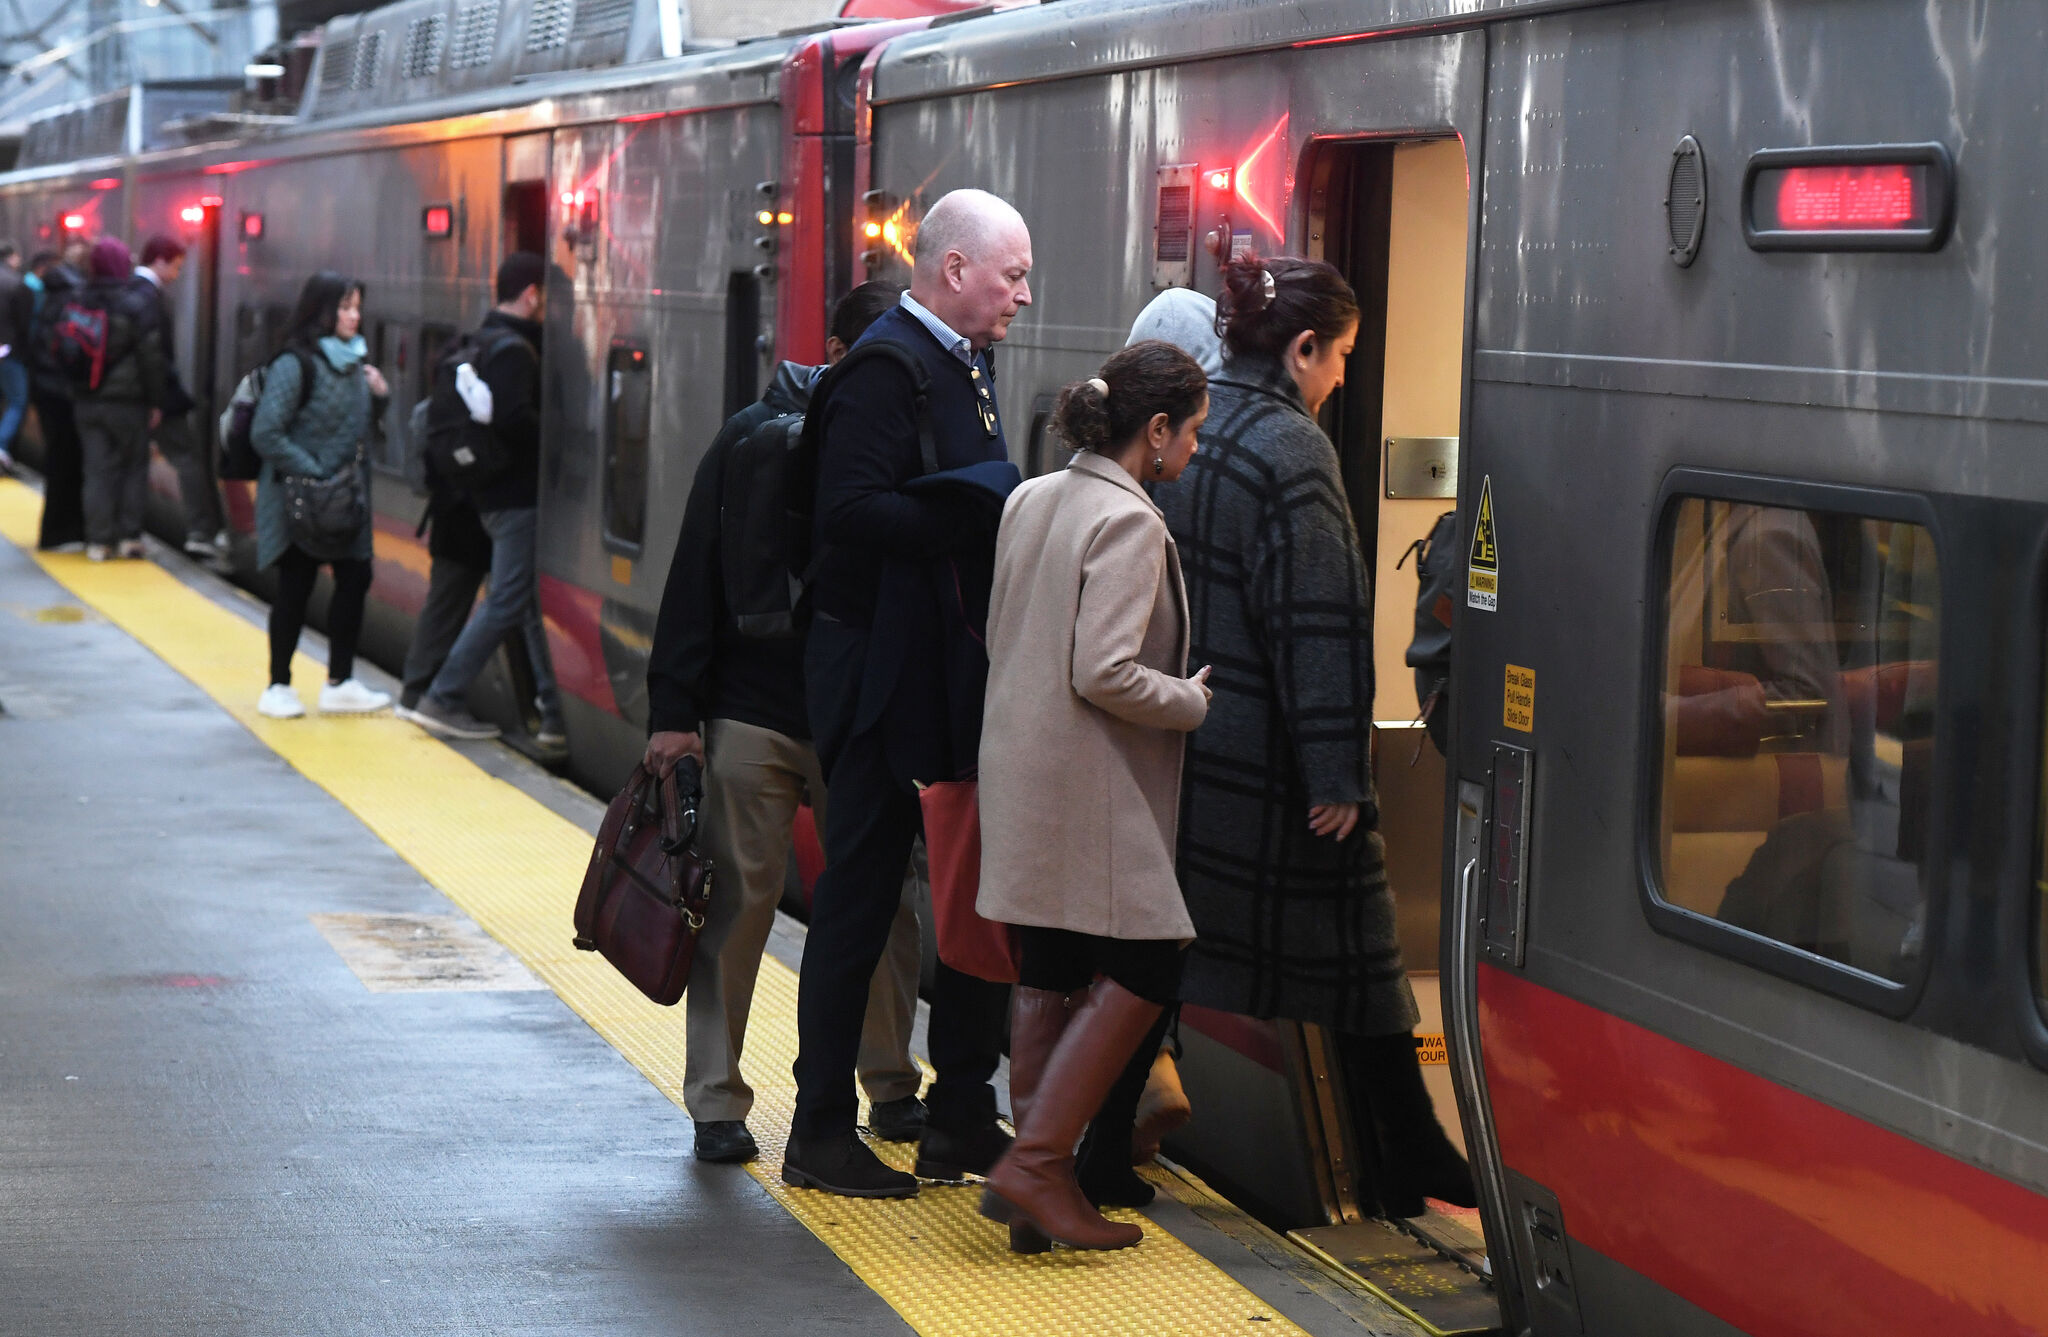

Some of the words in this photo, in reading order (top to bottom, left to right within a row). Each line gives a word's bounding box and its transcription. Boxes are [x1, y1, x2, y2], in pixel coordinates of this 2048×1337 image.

[1475, 575, 1495, 590] WARNING
[1506, 669, 1519, 686] Break
[1520, 672, 1533, 689] Glass
[1518, 711, 1530, 726] Door
[1424, 1036, 1445, 1048] WA
